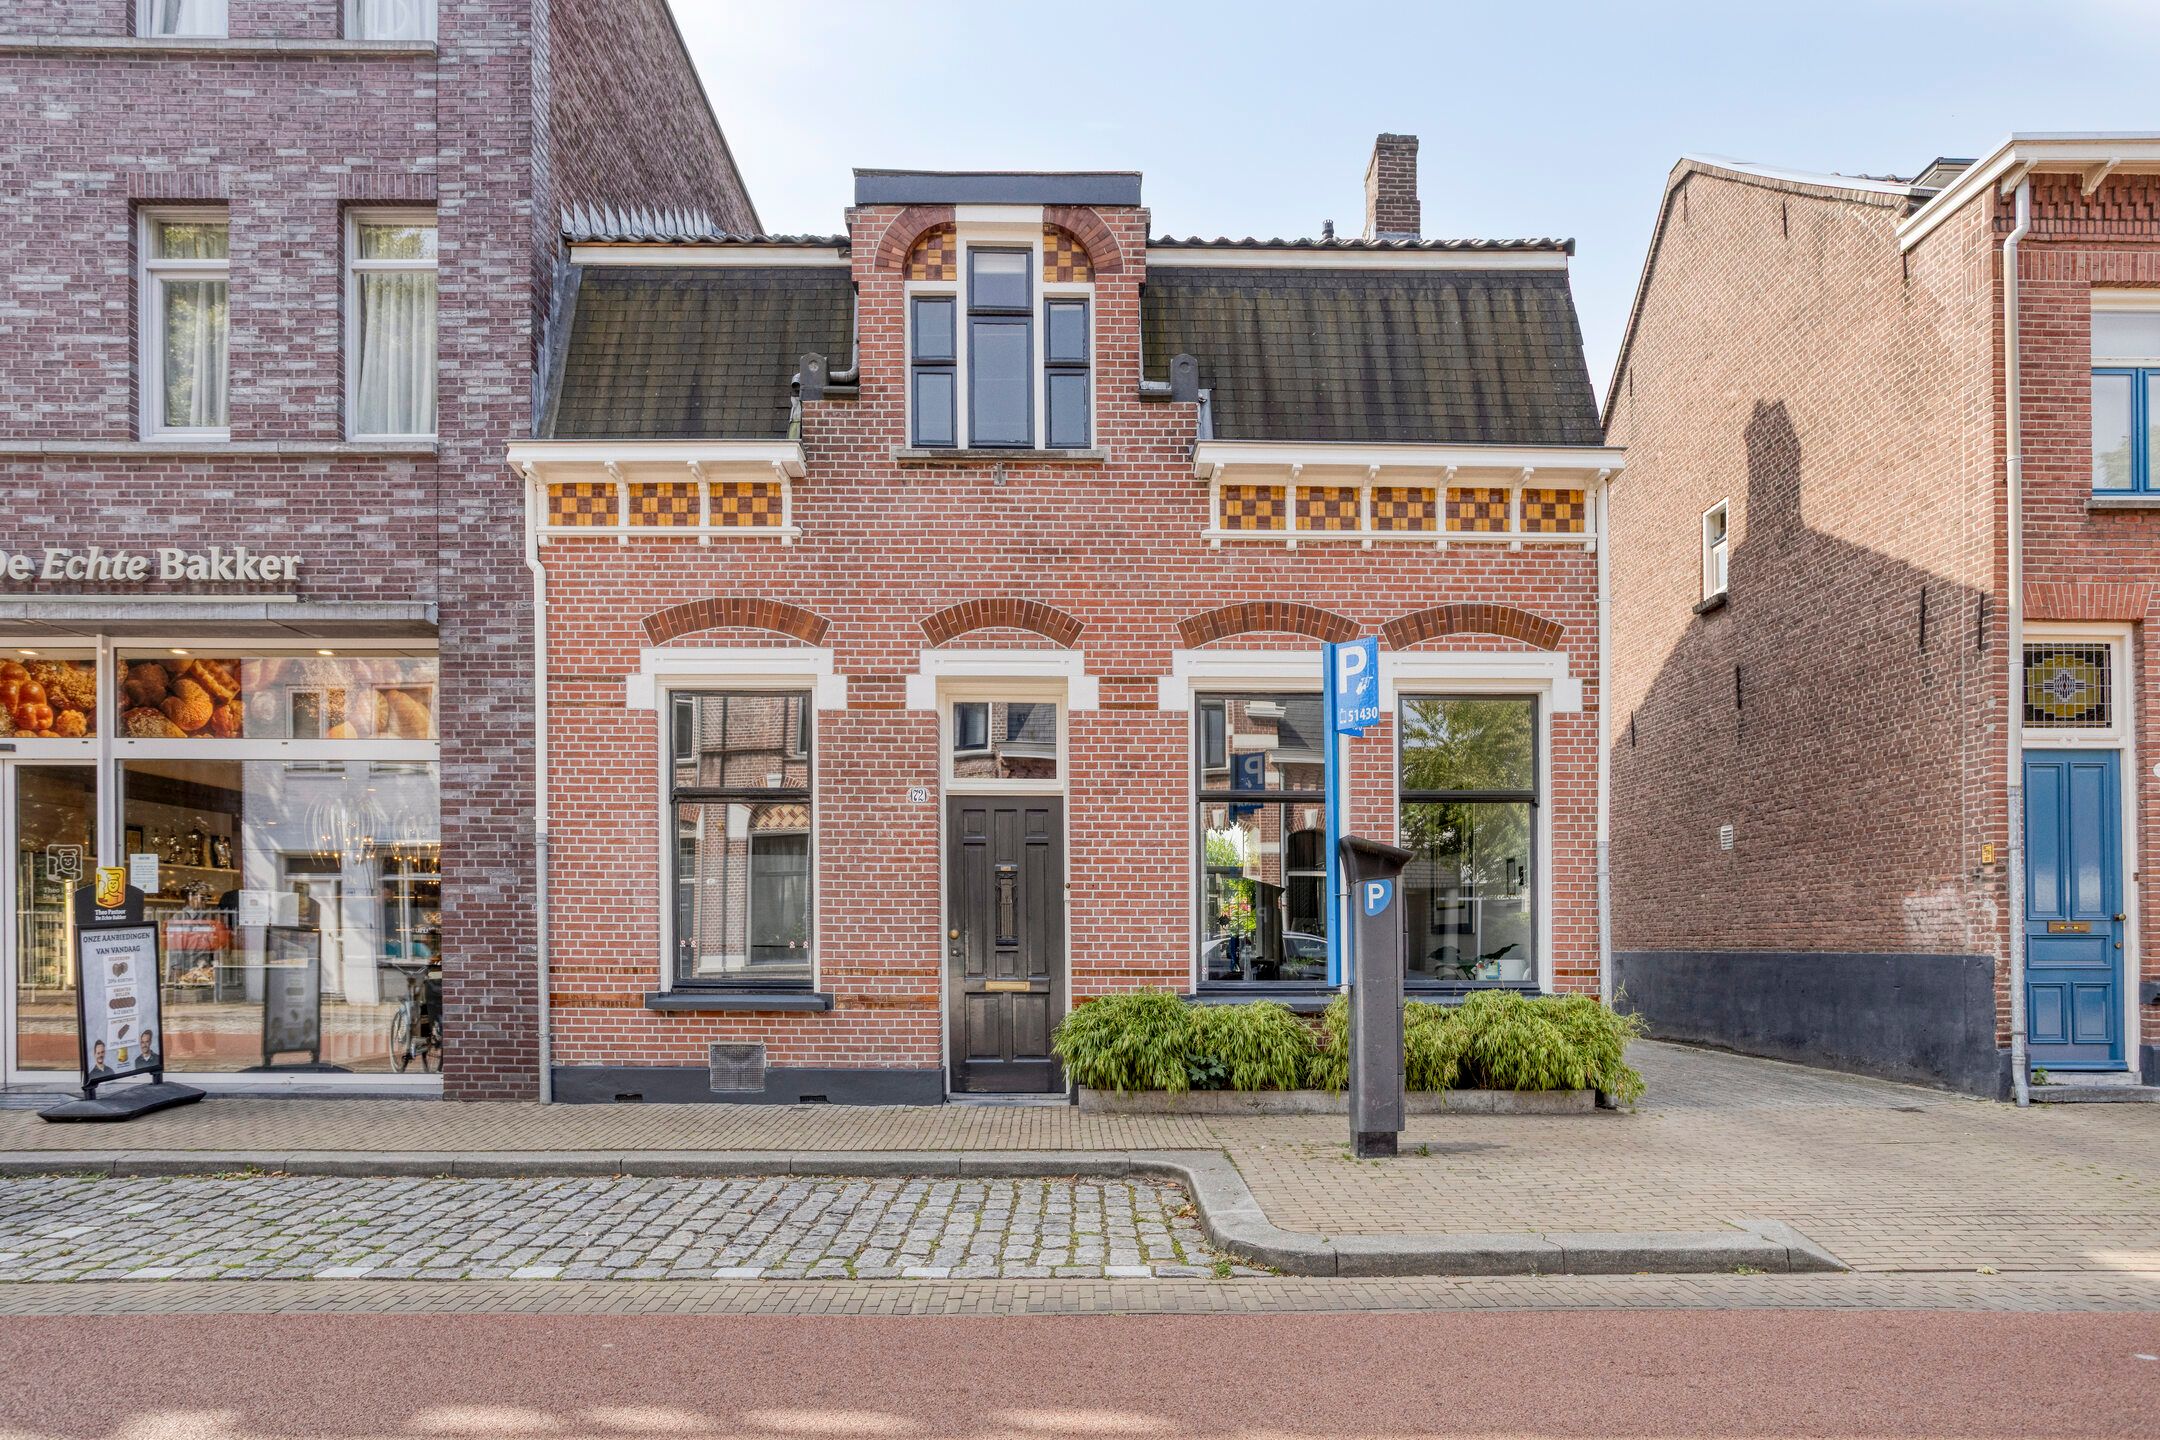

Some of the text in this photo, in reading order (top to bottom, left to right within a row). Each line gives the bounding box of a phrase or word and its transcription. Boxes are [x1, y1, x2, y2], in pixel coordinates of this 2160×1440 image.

[40, 546, 149, 581] Echte
[157, 546, 303, 582] Bakker
[1338, 645, 1367, 695] P
[1348, 706, 1378, 722] 51430
[913, 789, 924, 802] 72
[1367, 883, 1385, 910] P
[83, 932, 150, 943] ONZE AANBIEDINGEN
[110, 945, 141, 953] VANDAAG
